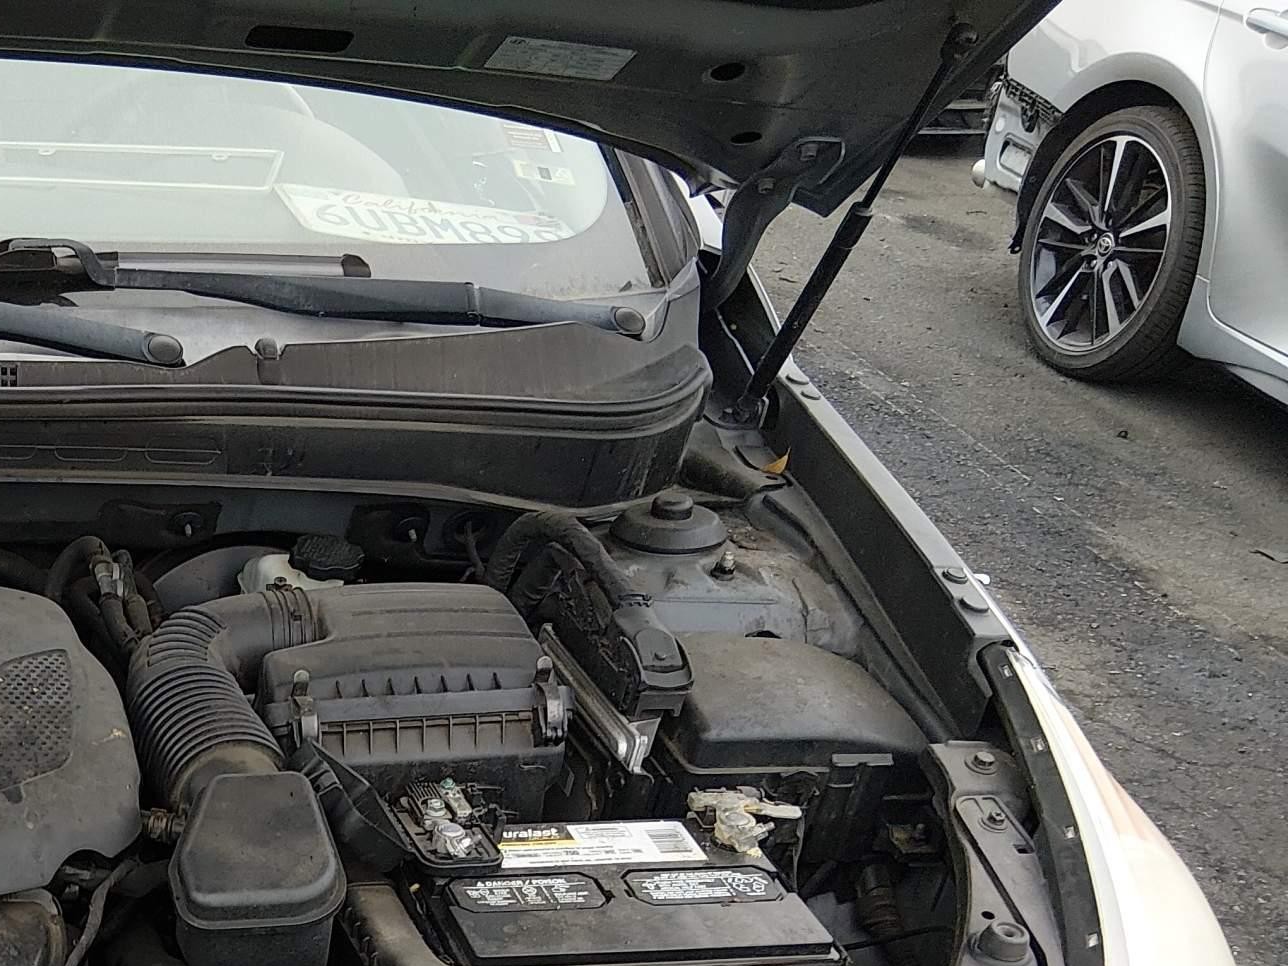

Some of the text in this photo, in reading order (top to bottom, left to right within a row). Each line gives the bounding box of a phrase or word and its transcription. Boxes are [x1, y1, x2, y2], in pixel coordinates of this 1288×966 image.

[502, 827, 559, 839] uralast
[485, 880, 523, 888] DANGER
[532, 878, 567, 886] POISON
